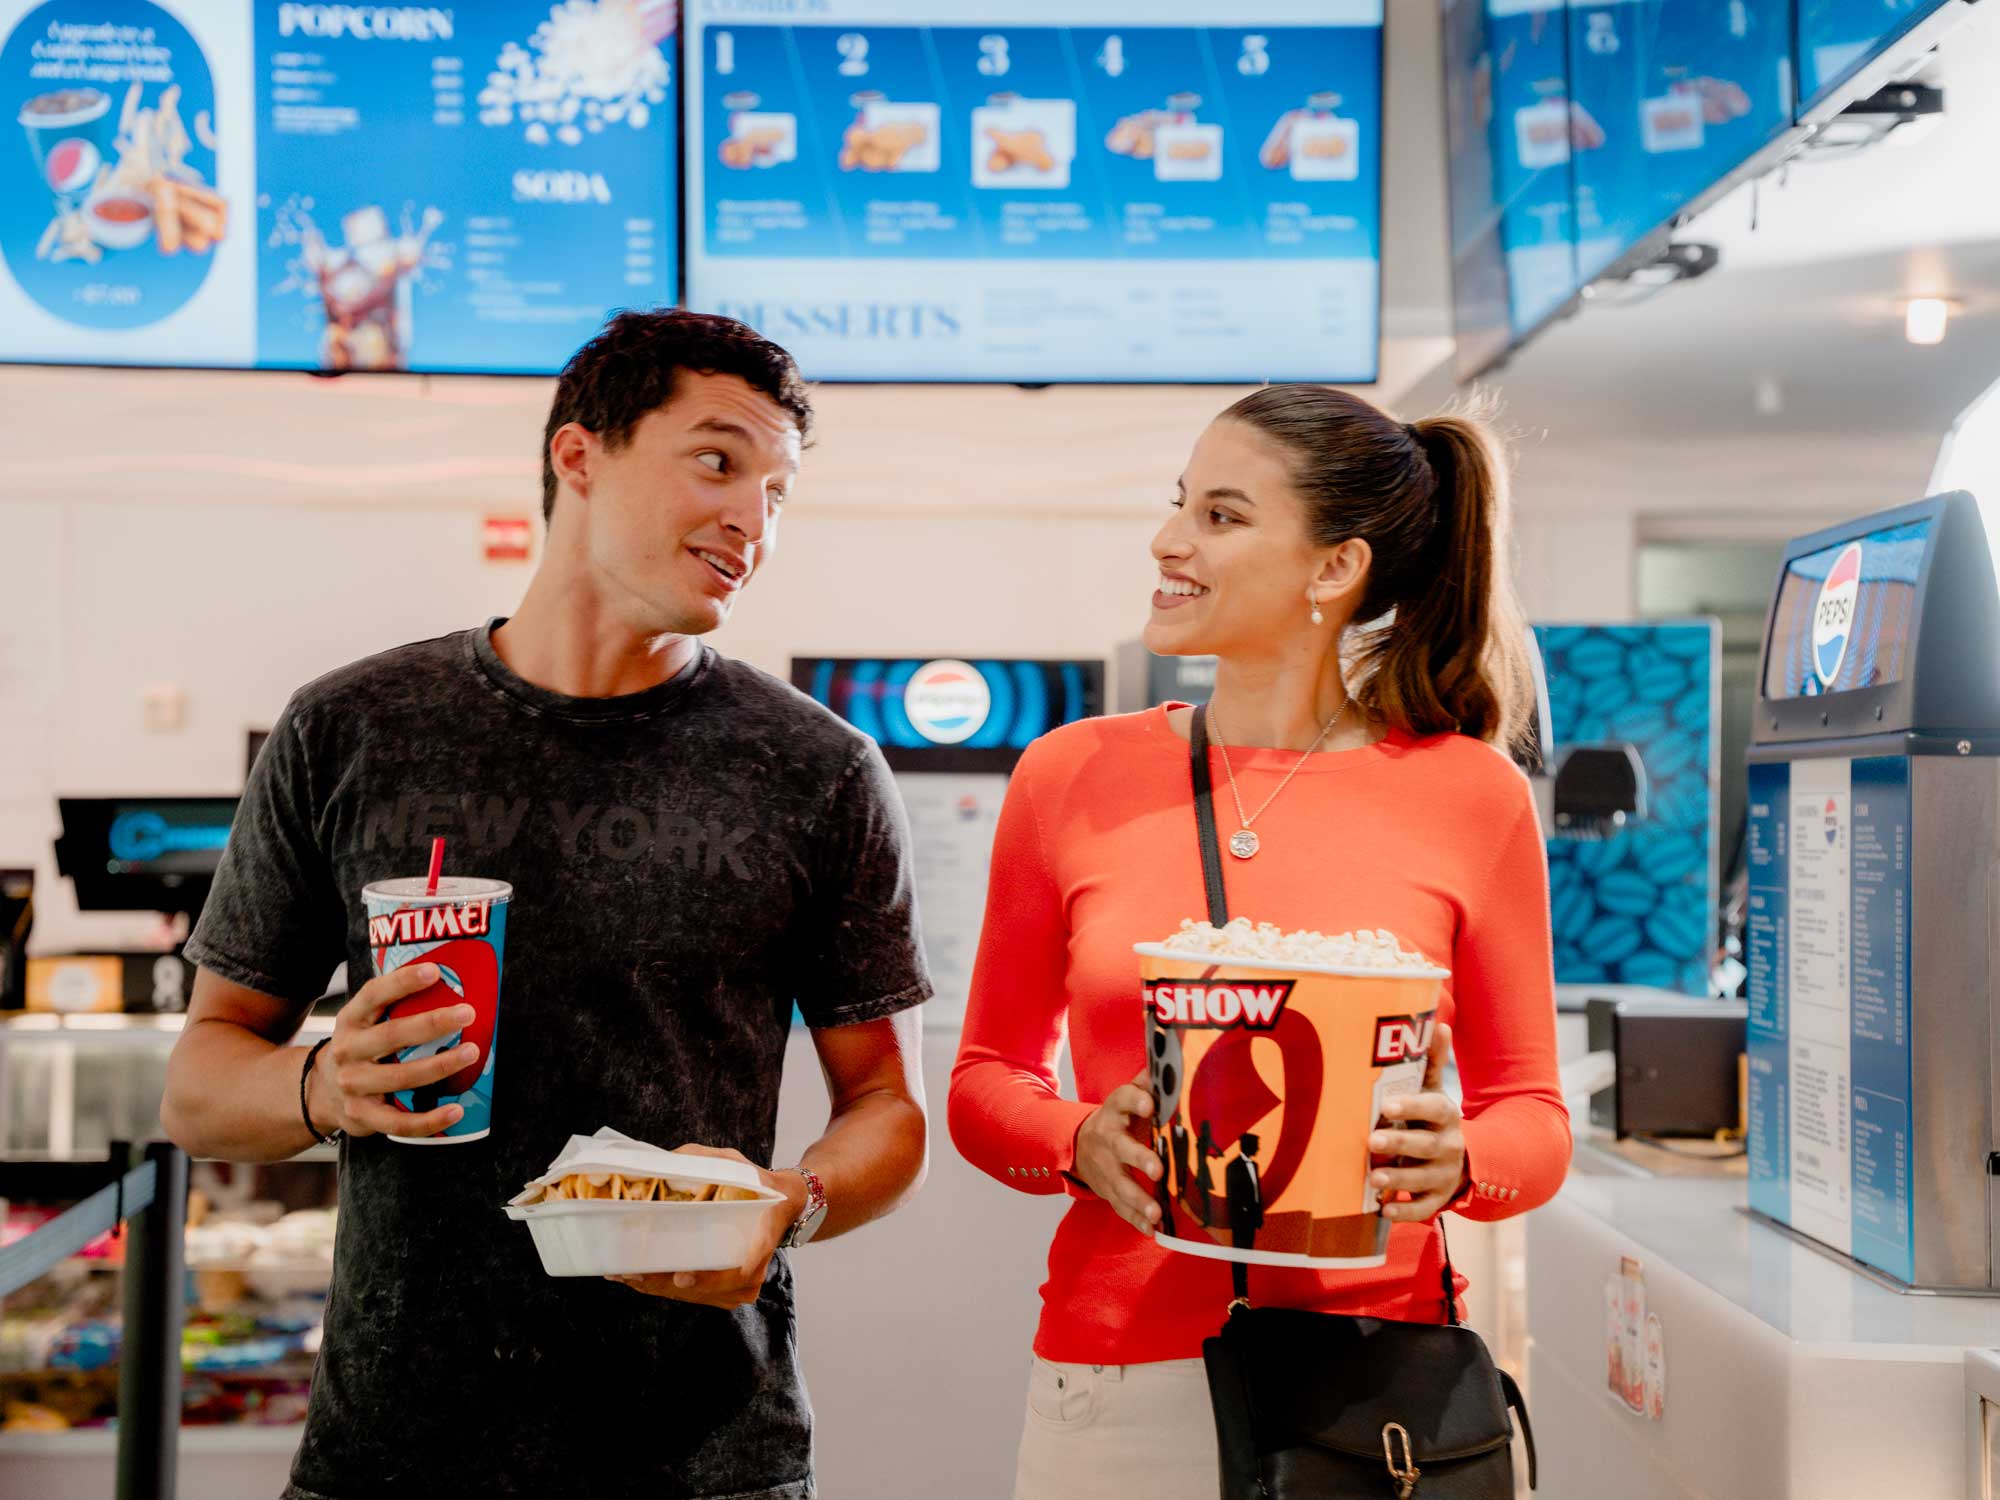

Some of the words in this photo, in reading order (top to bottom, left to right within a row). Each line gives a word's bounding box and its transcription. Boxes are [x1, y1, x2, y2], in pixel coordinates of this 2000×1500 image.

[279, 3, 454, 39] POPCORN
[716, 32, 734, 75] 1
[837, 33, 869, 76] 2
[977, 35, 1009, 76] 3
[1096, 35, 1124, 76] 4
[1238, 35, 1270, 76] 5
[512, 171, 611, 204] SODA
[361, 795, 530, 851] NEW
[550, 800, 756, 881] YORK
[1155, 986, 1283, 1023] SHOW
